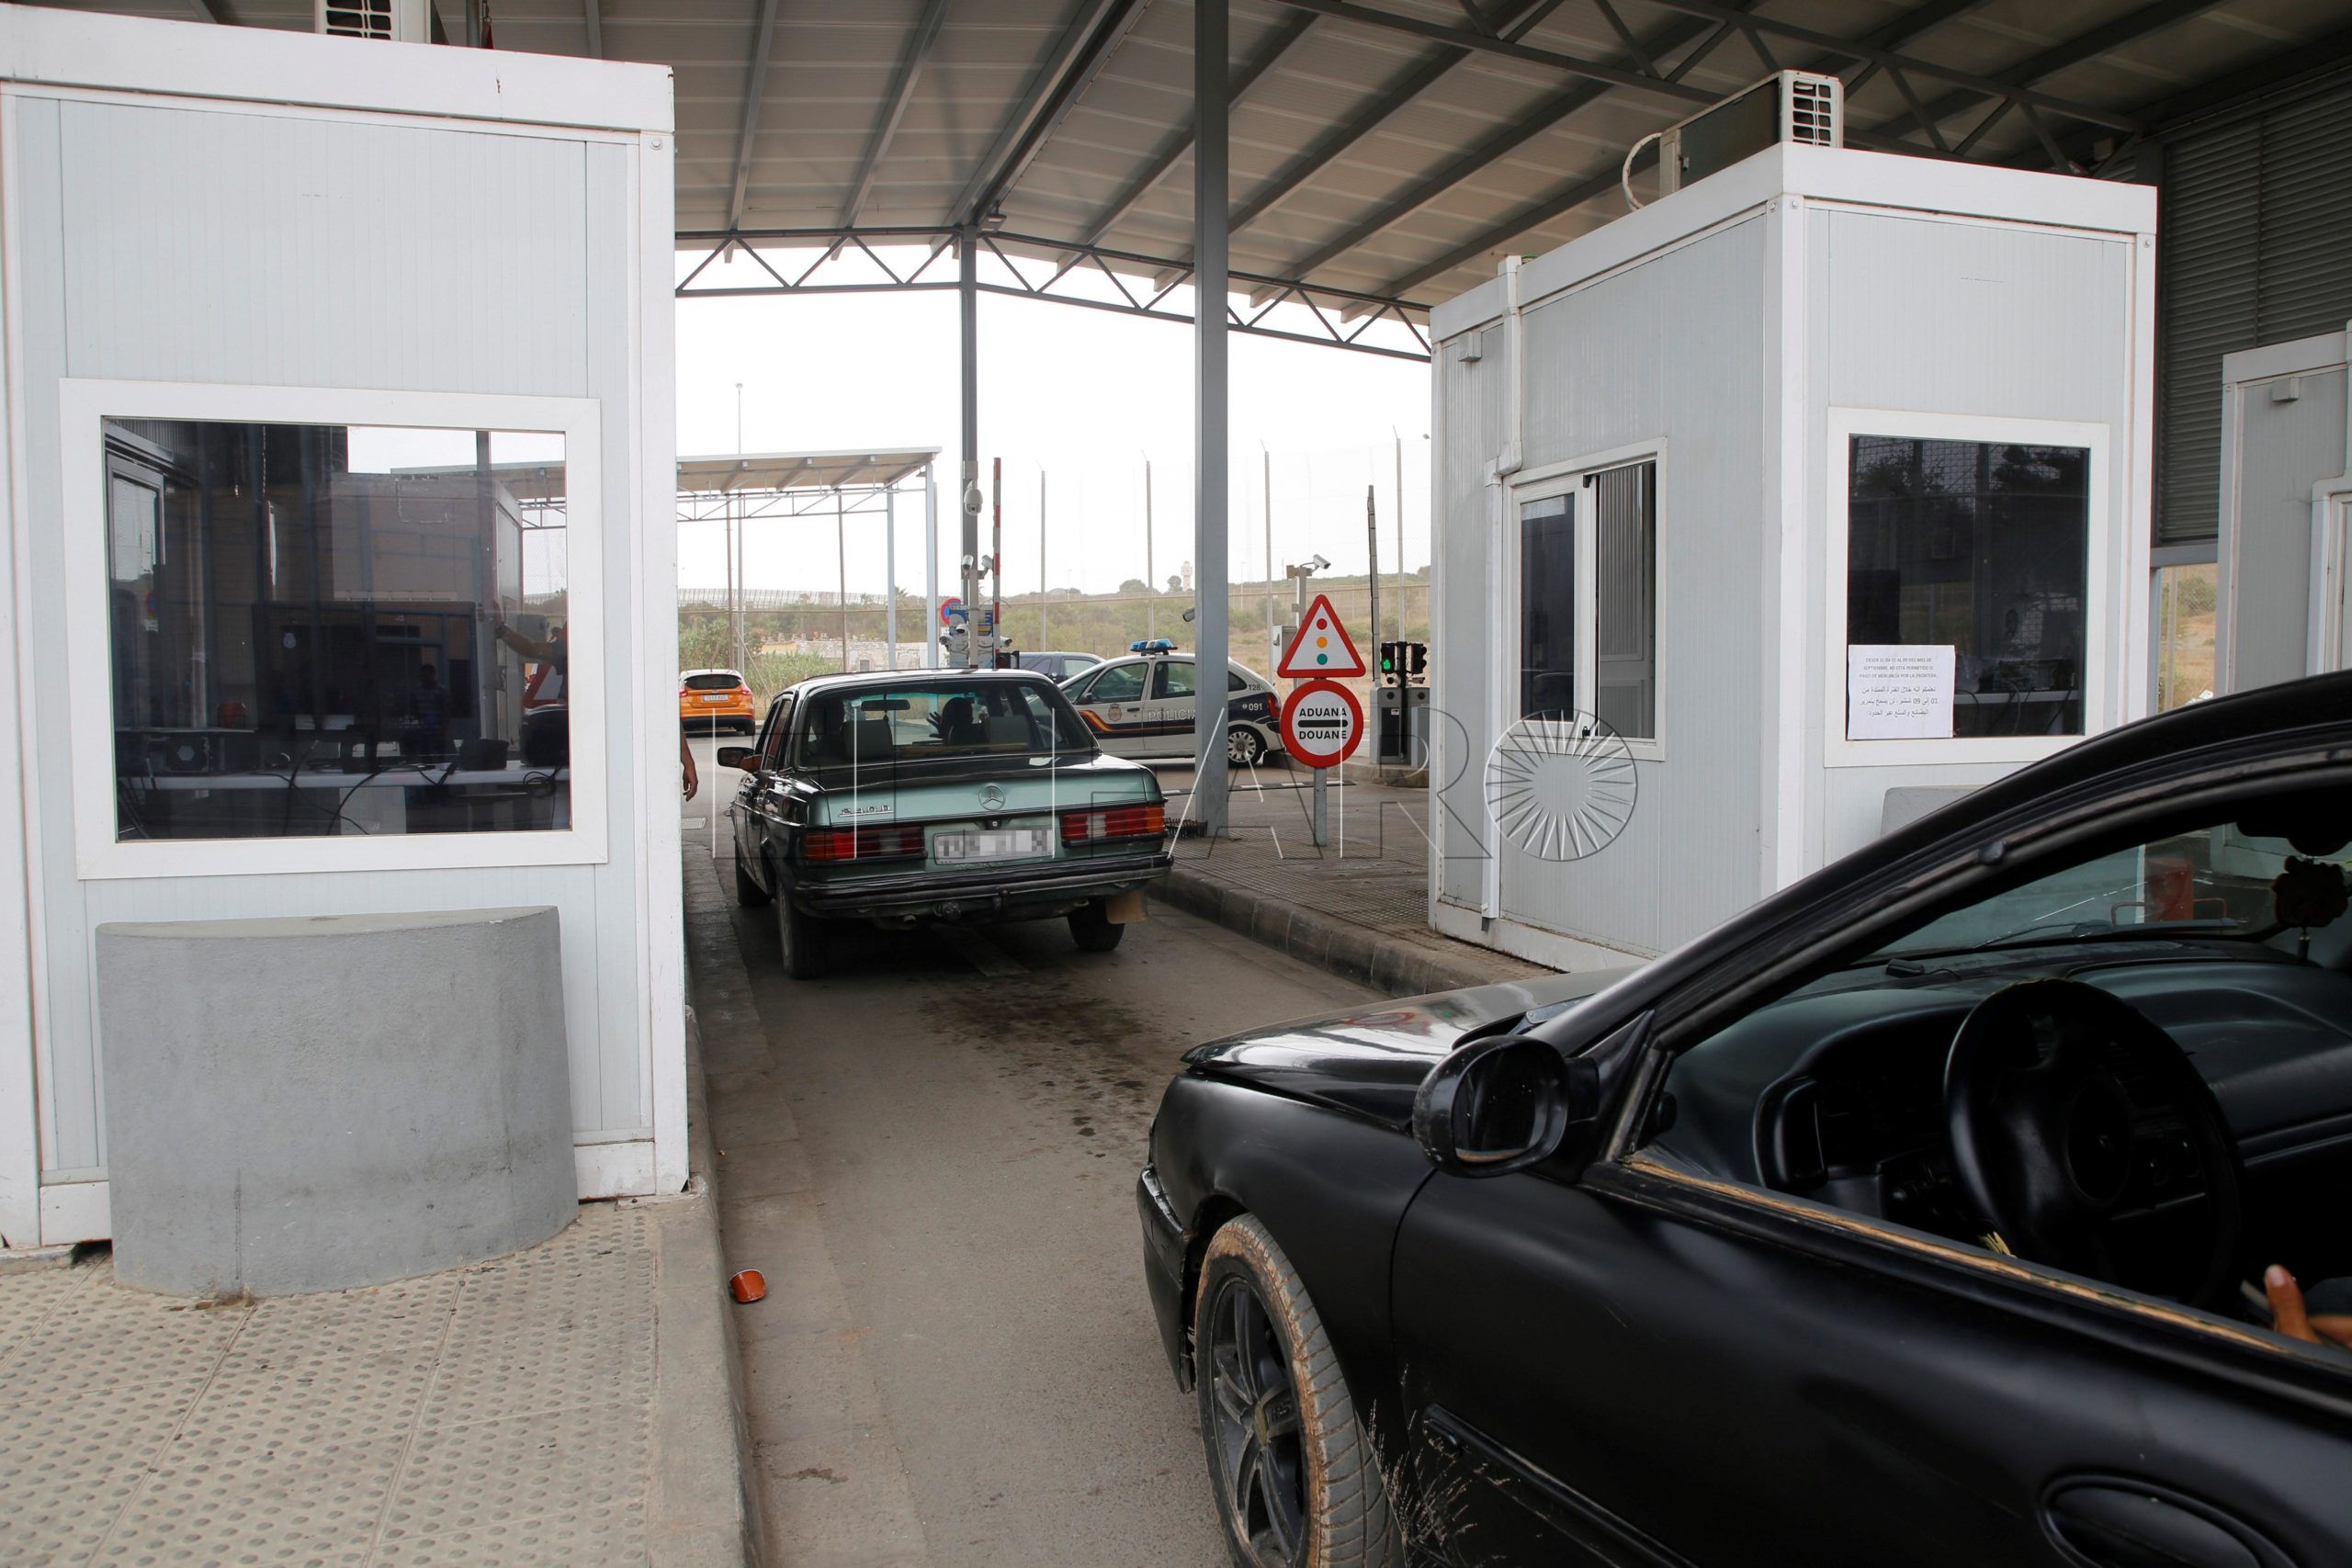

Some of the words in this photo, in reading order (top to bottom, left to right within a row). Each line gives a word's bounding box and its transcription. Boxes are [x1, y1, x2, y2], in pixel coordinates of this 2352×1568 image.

[1248, 702, 1263, 712] 091
[1298, 707, 1347, 717] ADUANA
[1298, 730, 1347, 739] DOUANE
